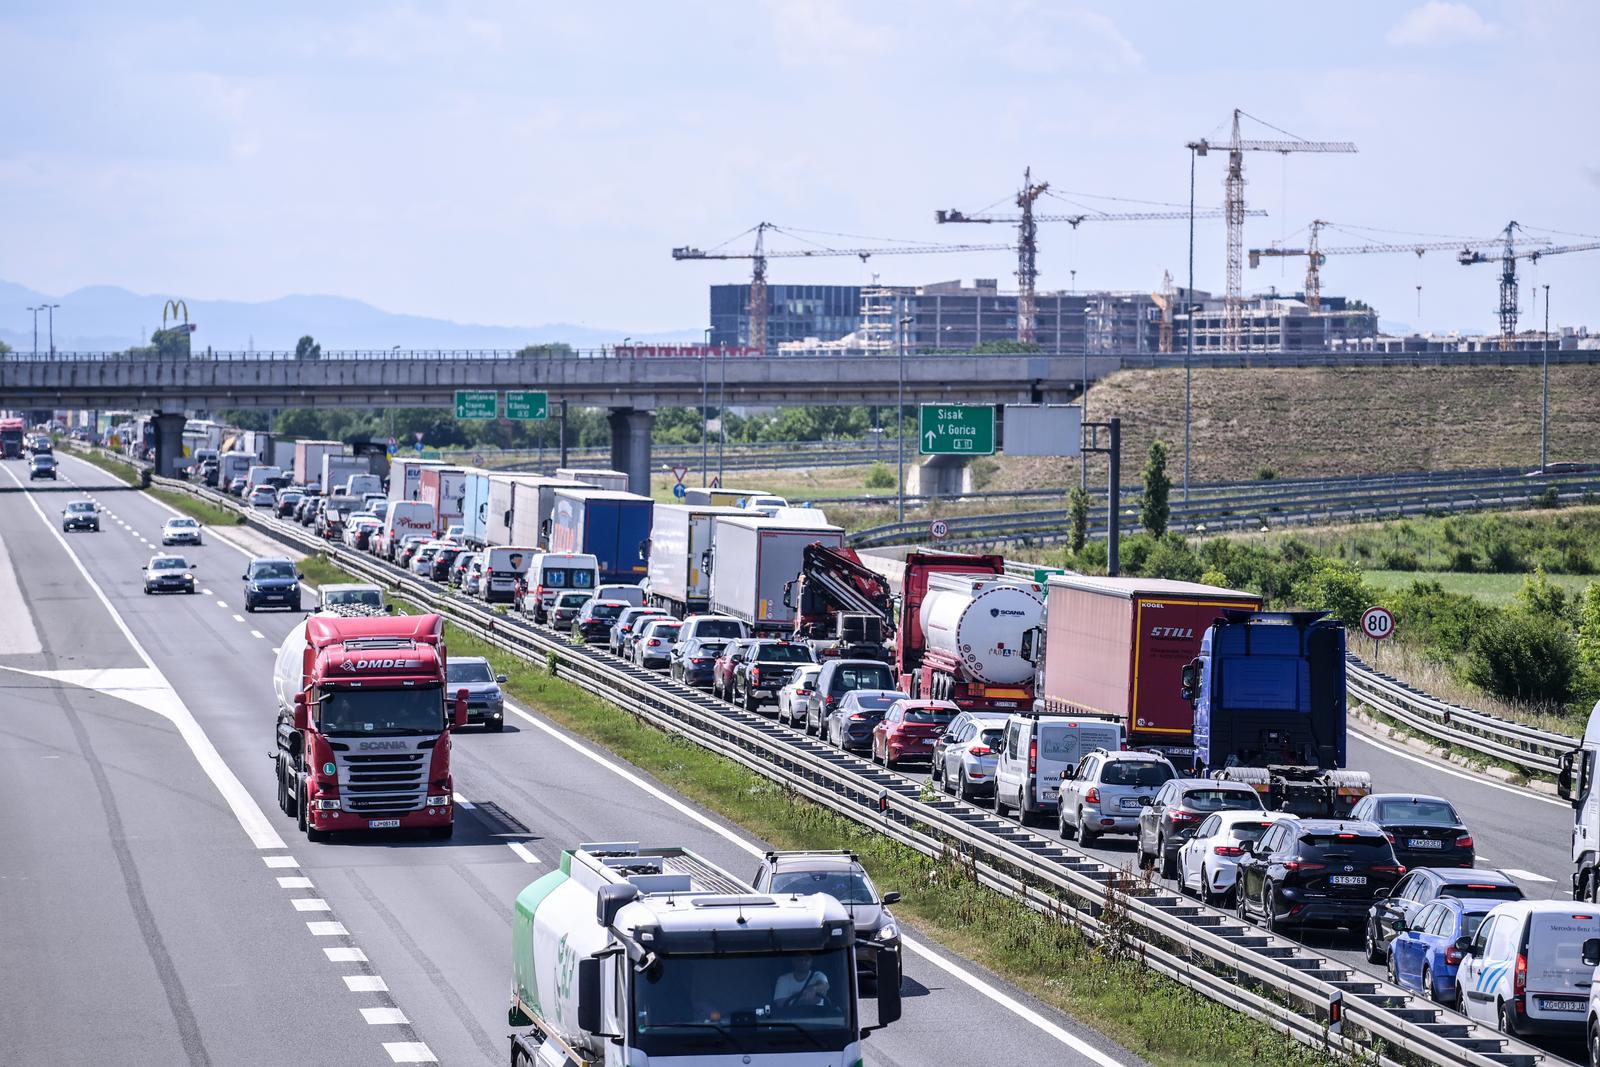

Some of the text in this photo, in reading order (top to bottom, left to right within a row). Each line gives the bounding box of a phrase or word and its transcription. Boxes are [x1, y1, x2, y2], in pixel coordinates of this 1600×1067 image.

[937, 409, 963, 420] Sisak
[937, 424, 976, 435] V. Gorica
[934, 524, 945, 534] 40
[1368, 615, 1387, 632] 80
[1151, 626, 1194, 638] STILL
[356, 659, 405, 669] DMDE
[359, 741, 408, 751] SCANIA
